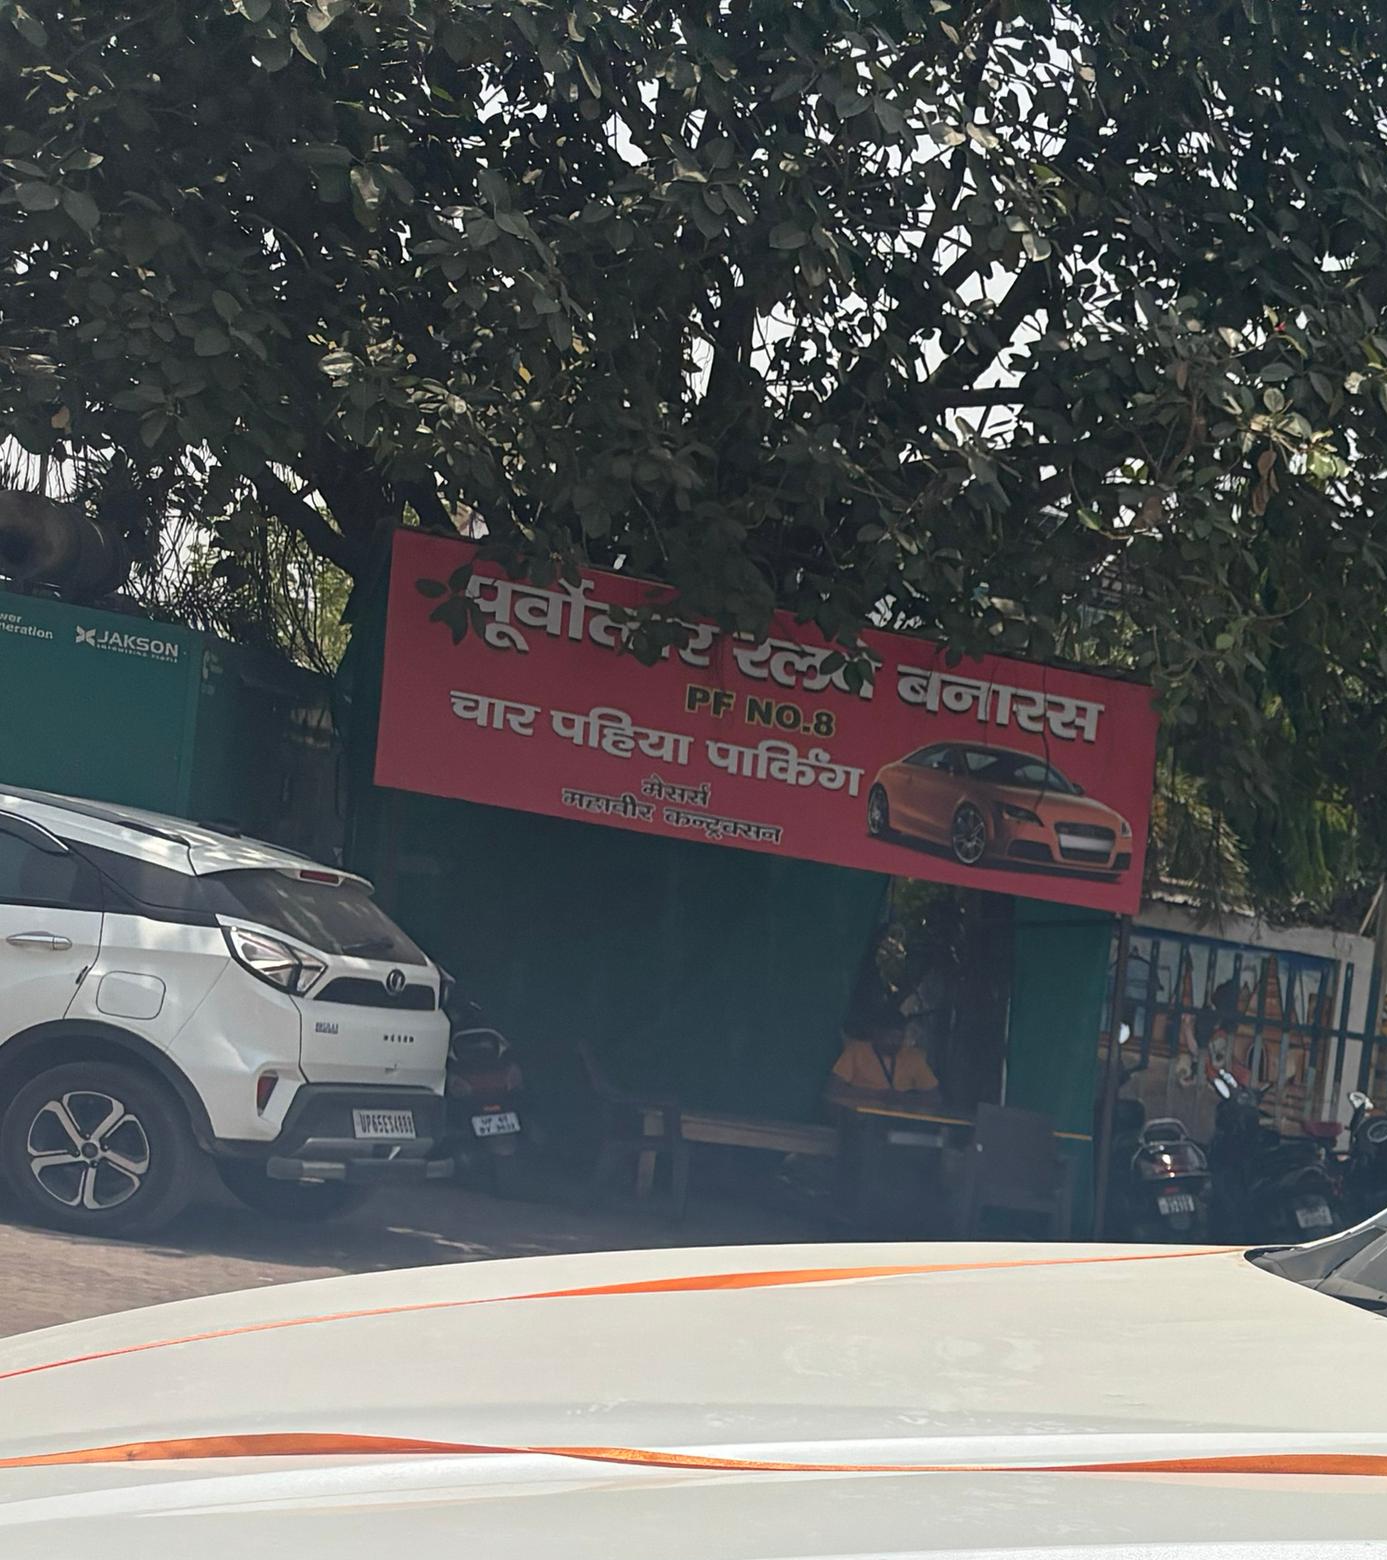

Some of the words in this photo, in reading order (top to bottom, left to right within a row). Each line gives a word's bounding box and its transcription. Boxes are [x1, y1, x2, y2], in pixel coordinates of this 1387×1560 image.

[97, 631, 178, 657] JAKSON
[450, 690, 541, 736] चार
[550, 707, 694, 765] पहिया
[685, 683, 737, 719] PF
[745, 695, 836, 738] NO.8
[897, 664, 1105, 742] बनारस
[561, 787, 656, 822] महावीर
